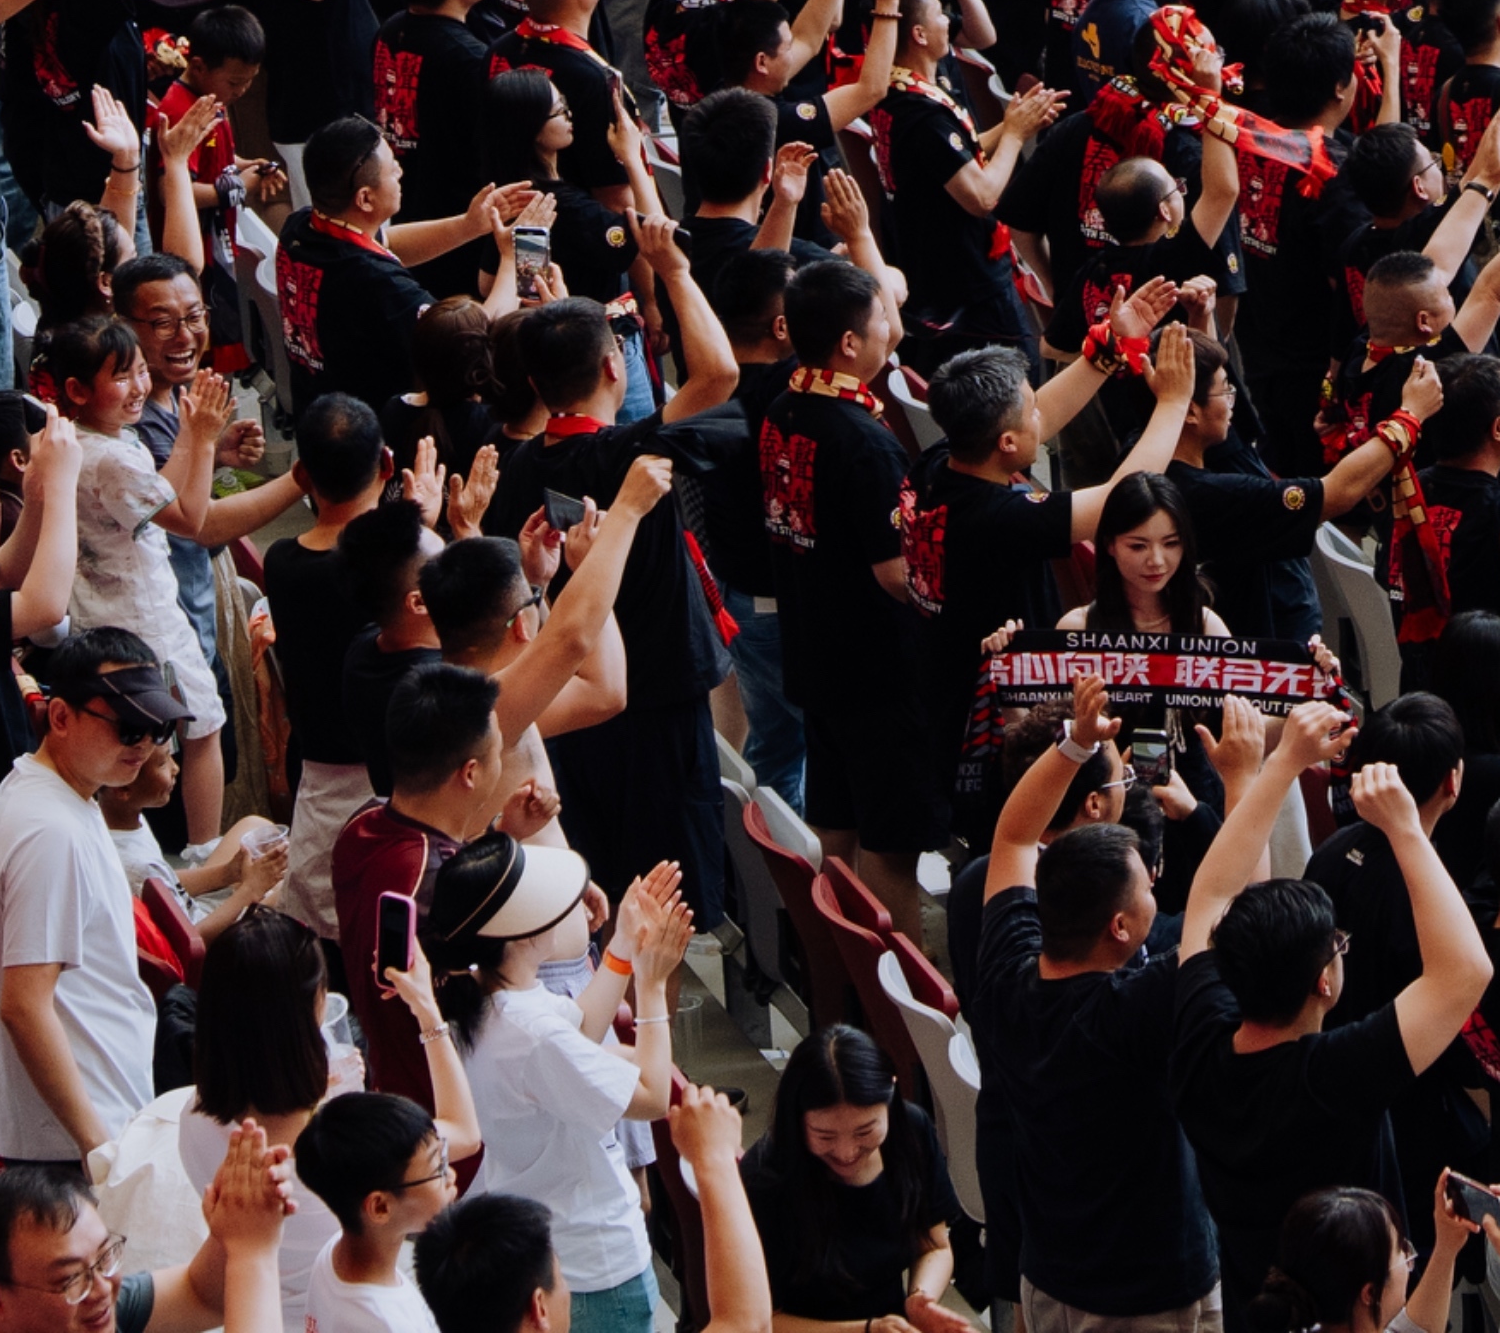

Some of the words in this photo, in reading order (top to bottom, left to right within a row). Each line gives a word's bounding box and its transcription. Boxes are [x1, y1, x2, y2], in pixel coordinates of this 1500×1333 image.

[1065, 632, 1170, 651] SHAANXI
[1180, 637, 1258, 655] UNION
[1106, 691, 1152, 704] HEART
[1165, 693, 1215, 709] UNION
